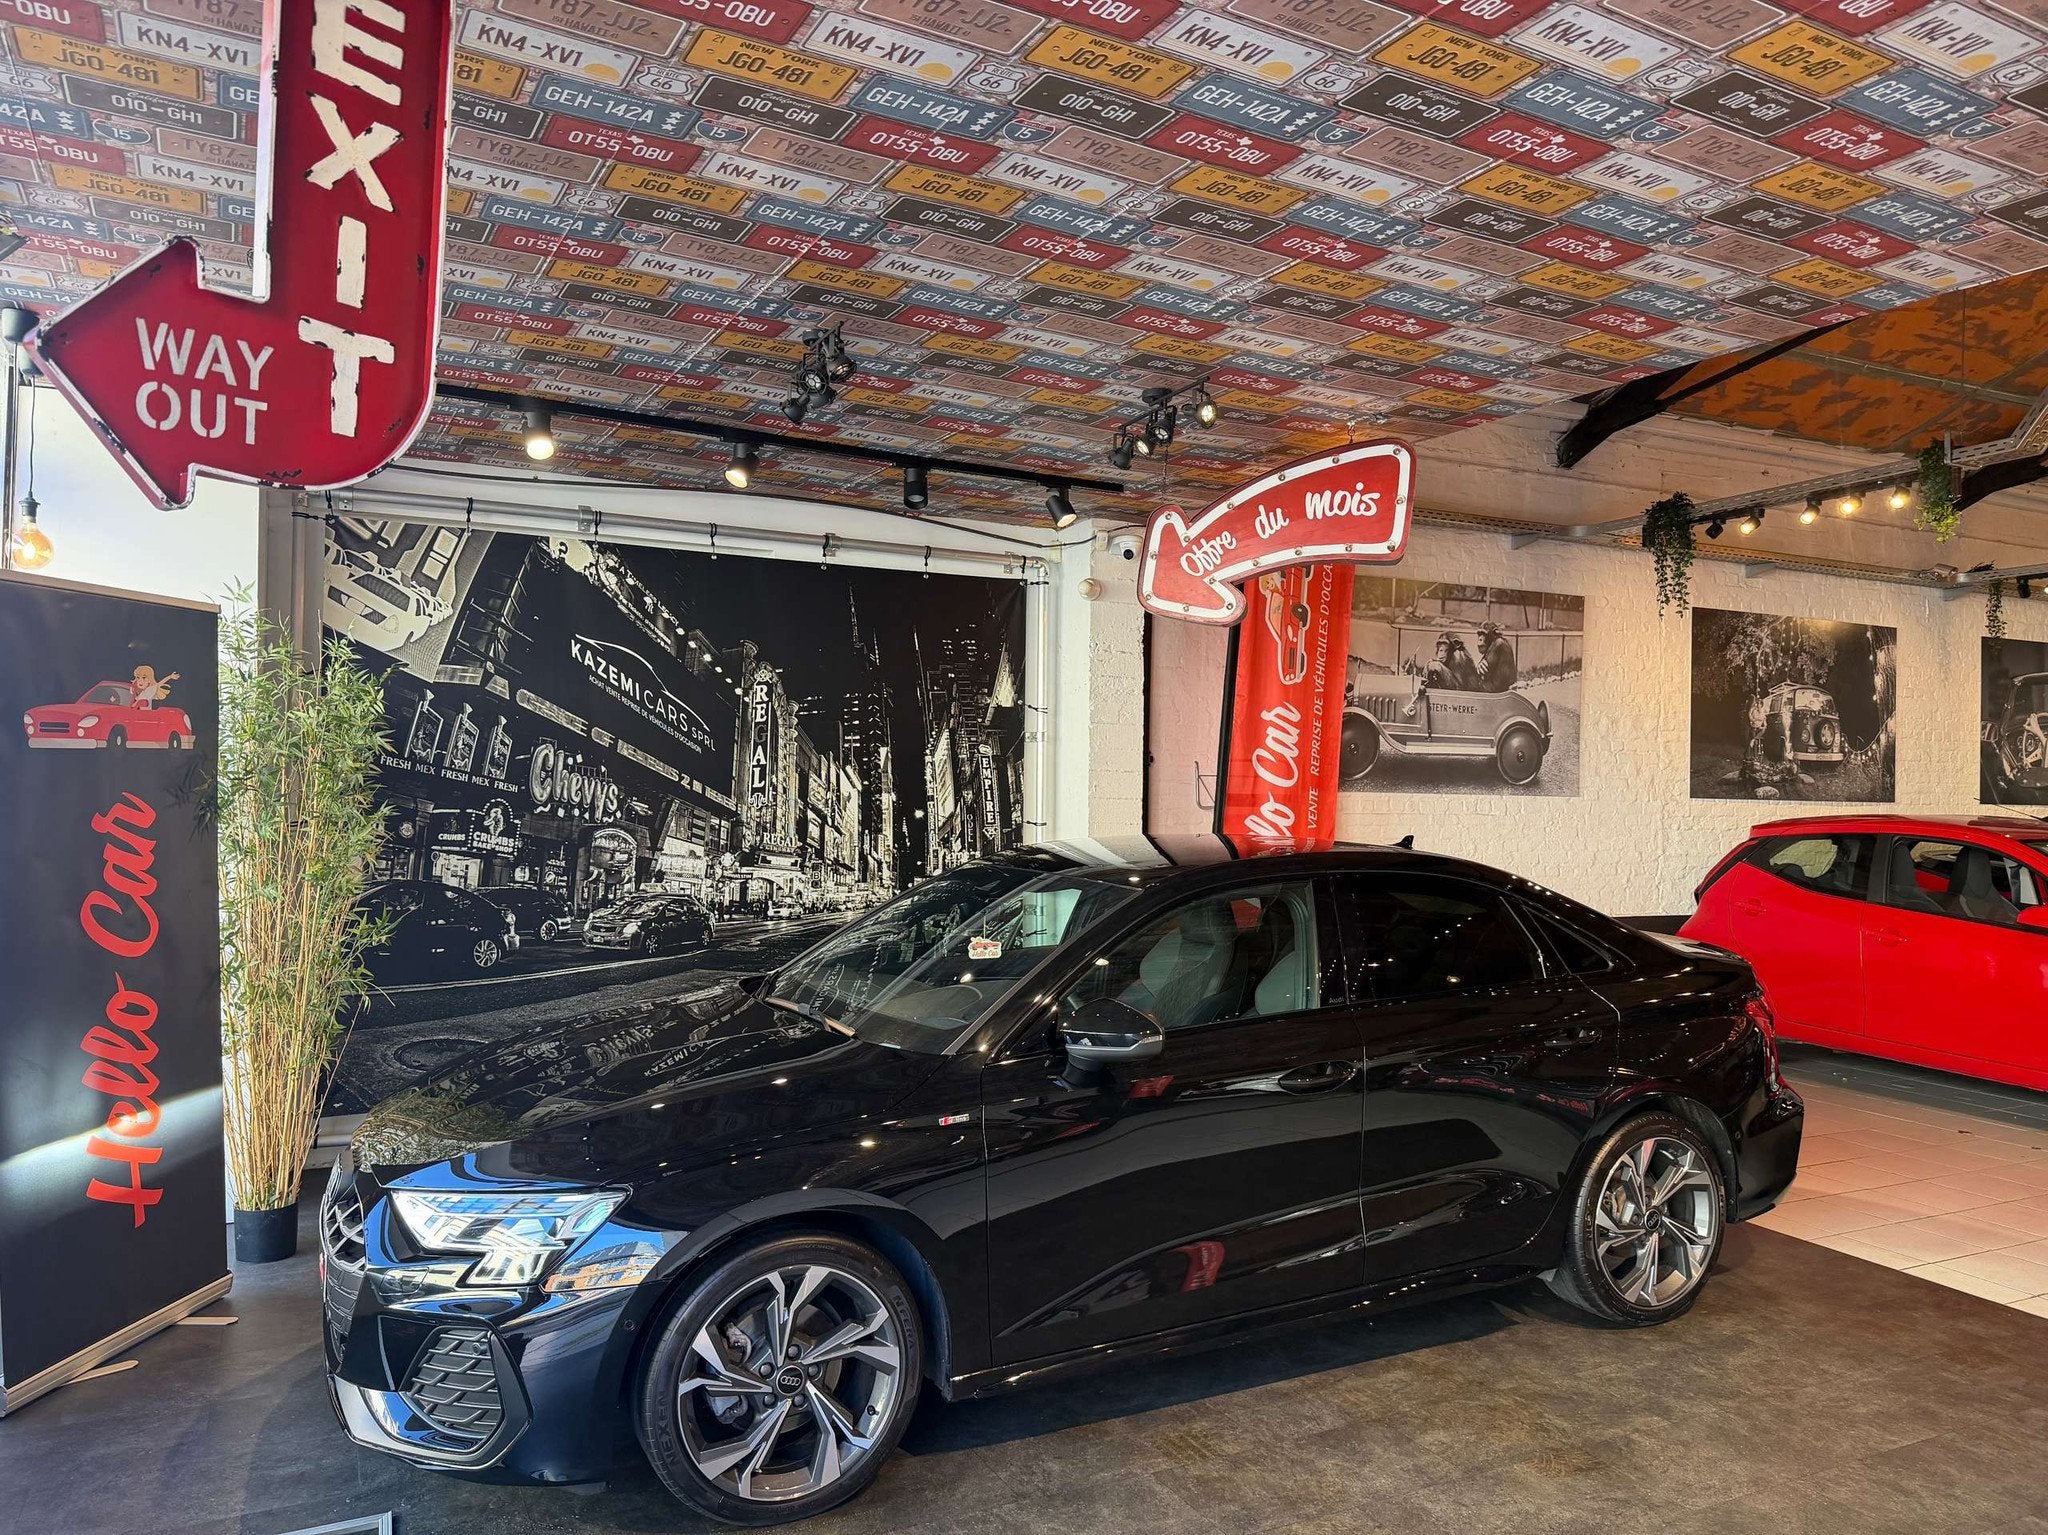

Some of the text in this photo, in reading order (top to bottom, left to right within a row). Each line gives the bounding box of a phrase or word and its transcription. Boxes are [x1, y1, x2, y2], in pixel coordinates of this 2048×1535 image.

[30, 33, 42, 41] 21
[137, 26, 248, 66] KN4-XV1
[477, 24, 583, 67] KN4-XV1
[713, 36, 725, 44] 21
[825, 26, 927, 67] KN4-XV1
[1064, 32, 1074, 40] 21
[1176, 24, 1274, 65] KN4-XV1
[1422, 29, 1440, 38] 21
[1536, 19, 1631, 61] KN4-XV1
[1808, 34, 1868, 61] NEW YORK
[740, 41, 821, 69] NEW YORK
[1089, 38, 1164, 65] NEW YORK
[1445, 36, 1513, 63] NEW YORK
[831, 67, 846, 77] 82
[1169, 64, 1185, 73] 82
[1514, 61, 1531, 72] 82
[1656, 73, 1684, 86] 66
[650, 77, 673, 90] 66
[980, 76, 1001, 89] 66
[1315, 75, 1336, 89] 66
[545, 86, 656, 123] GEH-142A
[867, 88, 969, 125] GEH-142A
[1193, 86, 1291, 124] GEH-142A
[1525, 83, 1619, 122] GEH-142A
[1864, 81, 1952, 119] GEH-142A
[599, 128, 622, 138] TEXAS
[710, 127, 731, 138] 15
[904, 129, 927, 139] TEXAS
[1014, 127, 1033, 139] 15
[1215, 129, 1237, 139] TEXAS
[1325, 128, 1344, 141] 15
[1531, 127, 1552, 137] TEXAS
[152, 163, 245, 192] KN4-XV1
[715, 161, 801, 192] KN4-XV1
[1004, 161, 1086, 191] KN4-XV1
[1297, 163, 1376, 192] KN4-XV1
[1594, 161, 1670, 190] KN4-XV1
[298, 0, 405, 437] EXIT
[491, 204, 584, 232] GEH-142A
[1581, 203, 1659, 232] GEH-142A
[641, 257, 715, 280] KN4-XV1
[134, 316, 274, 391] WAY
[134, 380, 268, 446] OUT
[1255, 504, 1290, 539] du
[1305, 482, 1381, 520] mois
[1320, 563, 1333, 616] D'OCCA
[1314, 695, 1324, 716] DE
[691, 727, 716, 751] SPRL
[752, 684, 769, 788] REGAL
[1252, 701, 1301, 787] Car
[1310, 717, 1322, 776] REPRISE
[380, 755, 518, 793] FRESH MEX FRESH MEX FRESH
[982, 757, 996, 823] EMPIRE
[1307, 786, 1319, 829] VENTE
[472, 831, 515, 847] CRUMBS
[80, 791, 164, 1229] Hello Car
